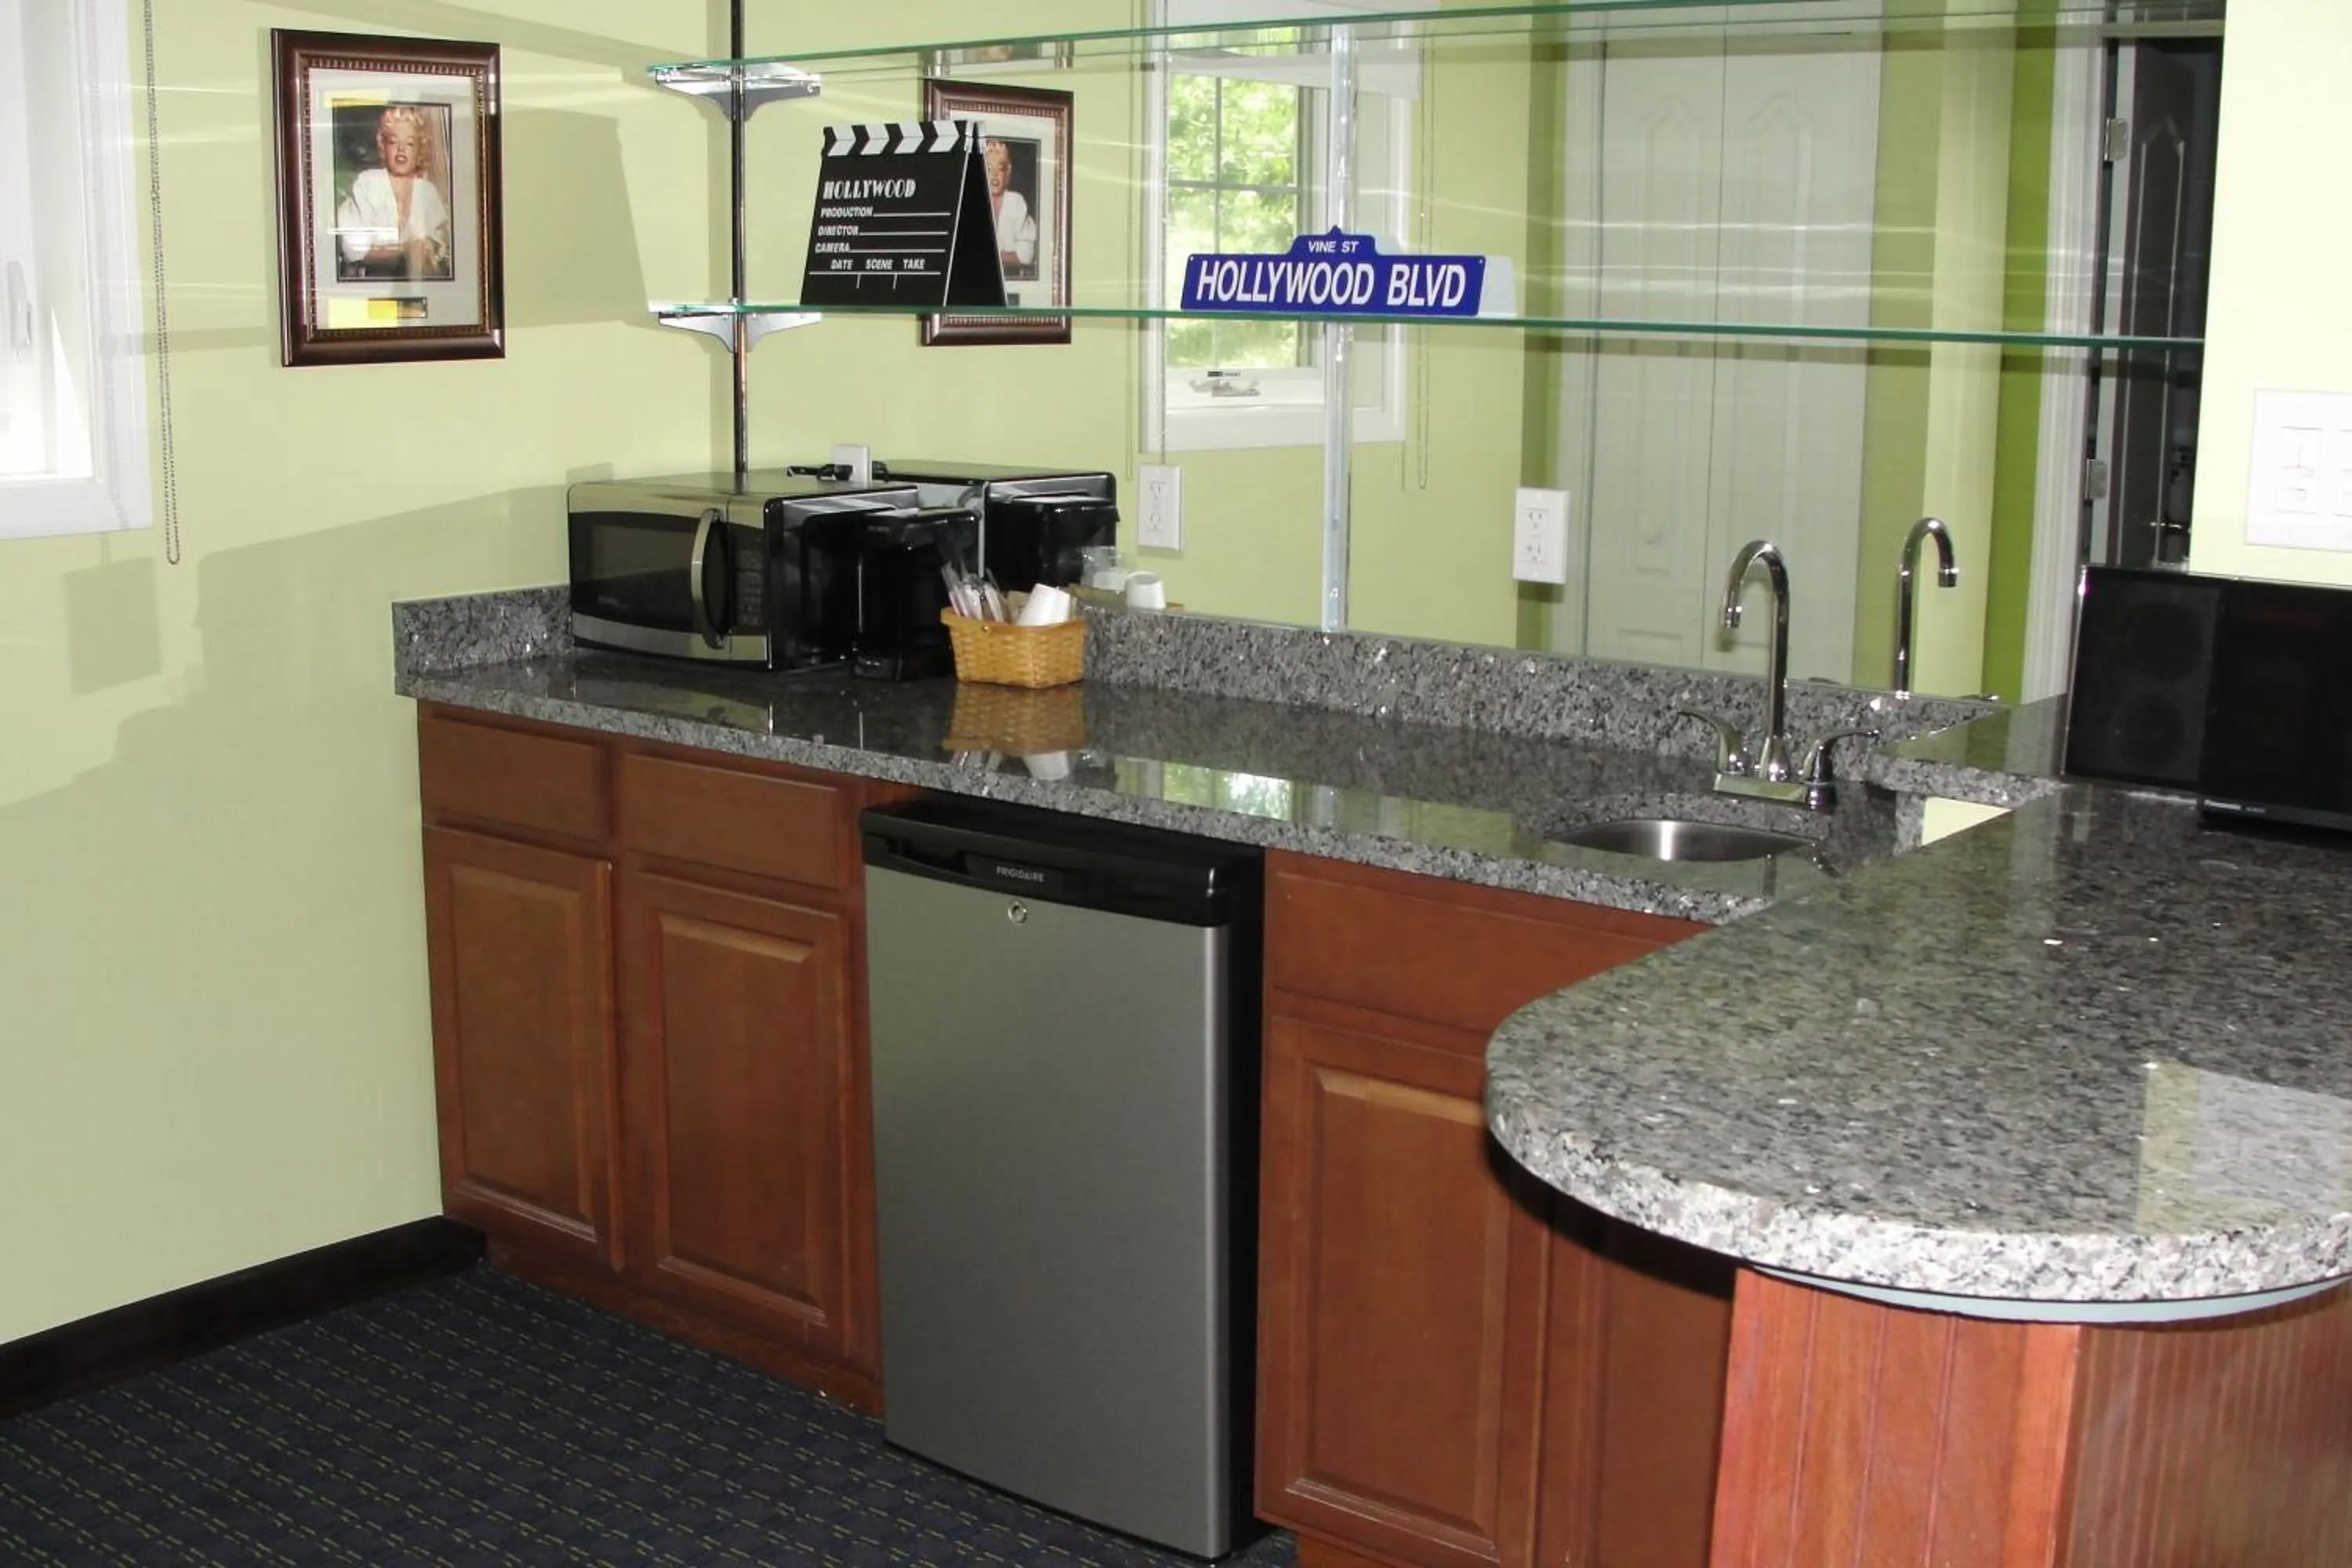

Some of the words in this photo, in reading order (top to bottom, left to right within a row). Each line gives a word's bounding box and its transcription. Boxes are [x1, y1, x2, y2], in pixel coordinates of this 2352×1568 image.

[823, 179, 916, 200] HOLLYWOOD
[821, 206, 874, 218] PRODUCTION
[818, 225, 859, 236] DIRECTOR
[815, 242, 851, 253] CAMERA
[1308, 240, 1336, 253] VINE
[1341, 241, 1359, 253] ST
[830, 259, 853, 270] DATE
[865, 259, 894, 270] SCENE
[902, 259, 926, 270] TAKE
[1196, 260, 1374, 307] HOLLYWOOD
[1386, 263, 1467, 308] BLVD
[996, 866, 1044, 883] FRIGIDAIRE
